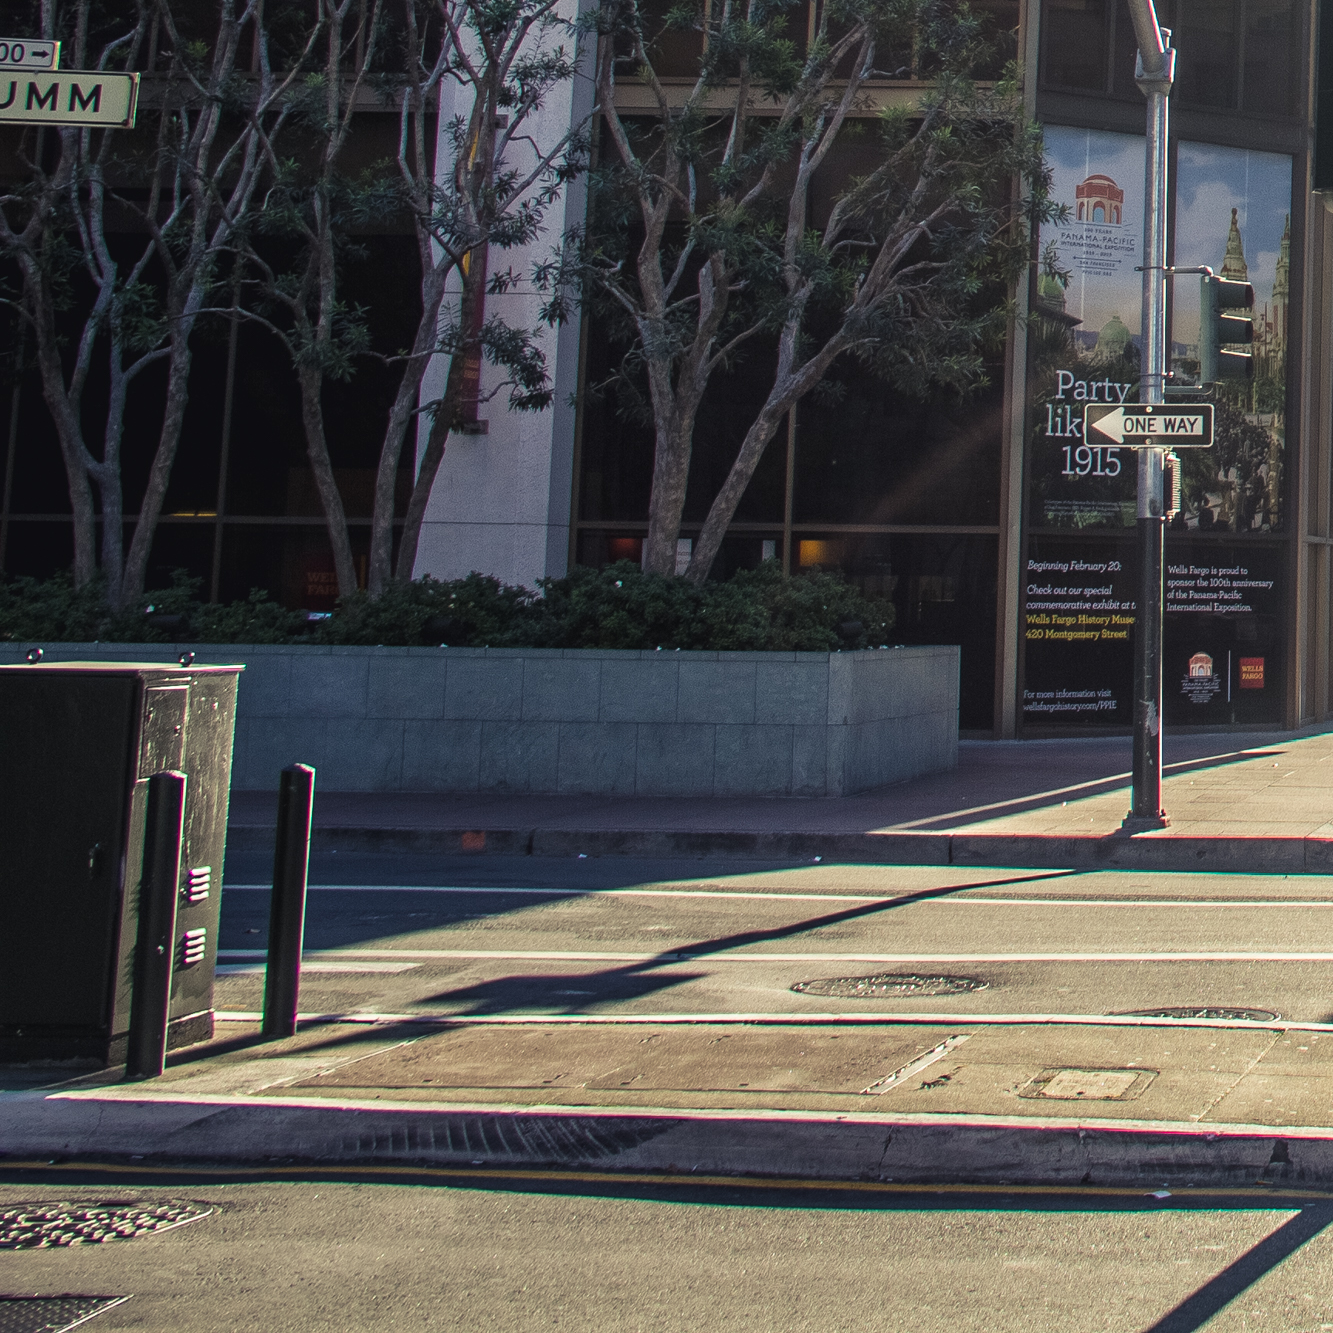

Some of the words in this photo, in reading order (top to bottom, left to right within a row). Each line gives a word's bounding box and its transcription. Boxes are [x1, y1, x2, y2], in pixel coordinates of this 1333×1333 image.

[0, 81, 102, 113] UMM
[1061, 233, 1135, 246] PANAMA-PACIFIC
[1061, 241, 1103, 249] INTERNATIONAL
[1056, 370, 1131, 404] Party
[1045, 404, 1085, 437] lik
[1124, 418, 1157, 433] ONE
[1164, 418, 1198, 433] WAY
[1062, 446, 1121, 476] 1915
[1027, 560, 1069, 572] Beginning
[1069, 560, 1107, 573] February
[1168, 564, 1188, 574] Wells
[1189, 566, 1209, 576] Fargo
[1211, 566, 1217, 574] is
[1219, 566, 1239, 576] proud
[1240, 567, 1248, 575] to
[1167, 579, 1195, 588] sponsor
[1197, 578, 1208, 586] the
[1210, 578, 1231, 586] 100th
[1232, 579, 1273, 589] anniversary
[1027, 584, 1052, 594] Check
[1053, 586, 1067, 594] out
[1083, 584, 1113, 597] special
[1167, 589, 1175, 599] of
[1176, 589, 1188, 598] the
[1189, 590, 1242, 599] Panama-Pacific
[1026, 600, 1091, 609] commemorative
[1093, 599, 1120, 610] exhibit
[1121, 601, 1130, 609] at
[1166, 602, 1212, 611] International
[1214, 602, 1252, 613] Exposition.
[1026, 614, 1050, 624] Wells
[1052, 615, 1076, 626] Fargo
[1078, 614, 1110, 625] History
[1111, 614, 1136, 624] Muse
[1026, 629, 1044, 638] 420
[1045, 629, 1100, 641] Montgomery
[1101, 629, 1127, 639] Street
[1023, 690, 1034, 698] For
[1056, 688, 1096, 698] information
[1097, 689, 1111, 697] visit
[1023, 700, 1117, 713] wellsfargohistory.com/PPIE
